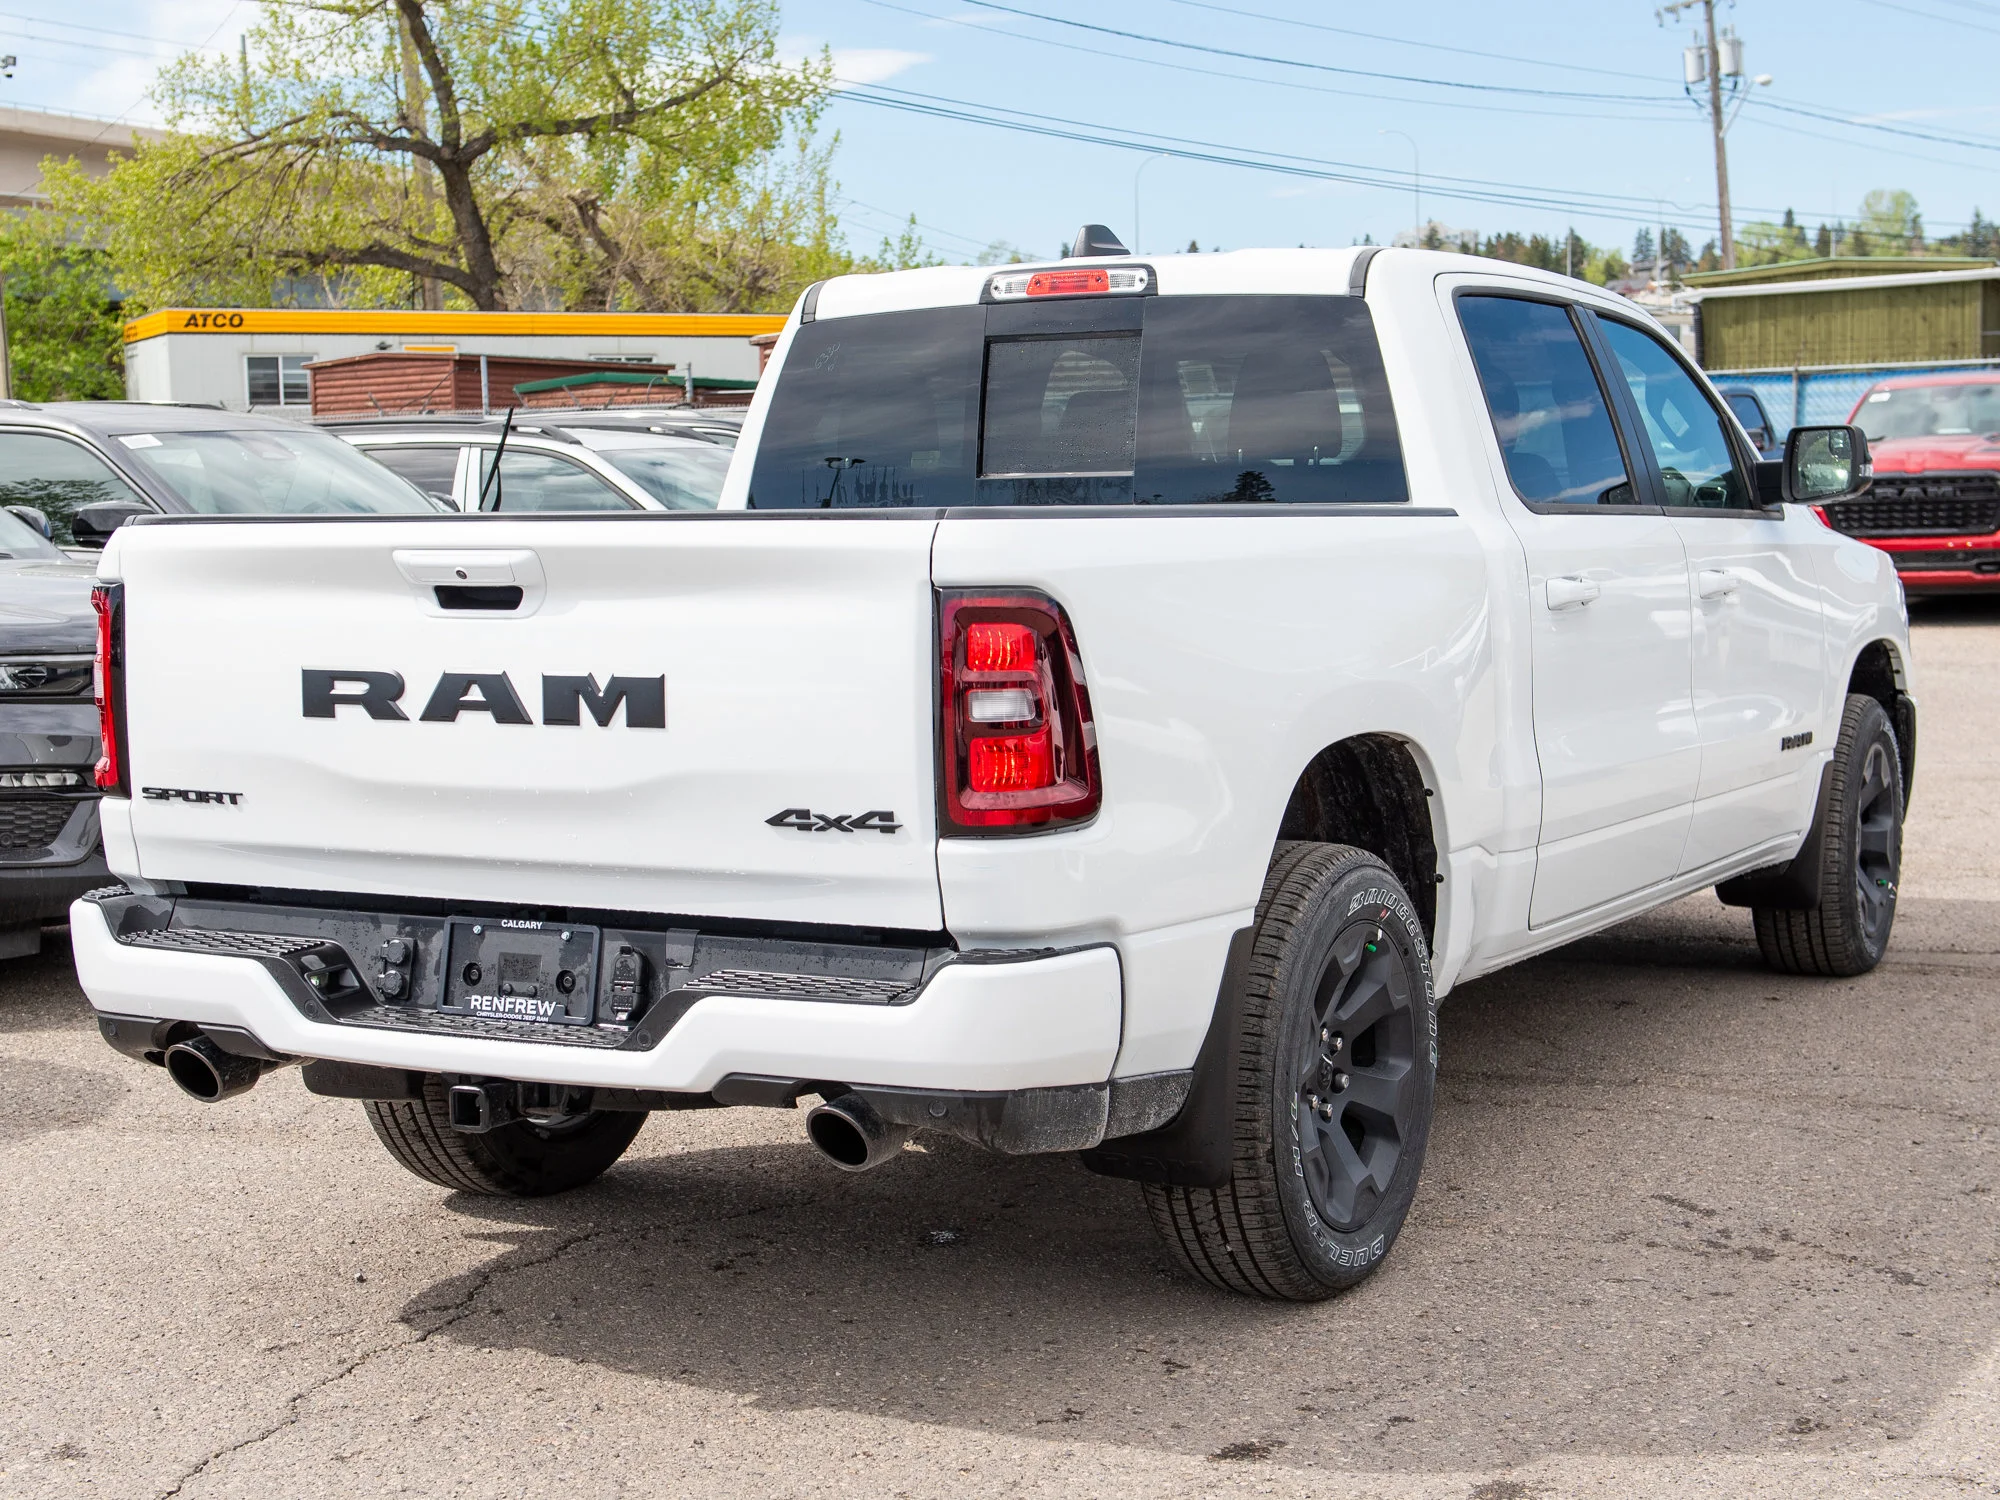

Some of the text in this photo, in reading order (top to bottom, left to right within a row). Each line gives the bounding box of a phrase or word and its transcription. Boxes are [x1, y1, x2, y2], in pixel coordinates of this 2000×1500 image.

[184, 313, 244, 328] ATCO
[302, 665, 665, 729] RAM
[1781, 731, 1813, 751] RAM
[142, 786, 243, 805] SPORT
[764, 808, 903, 834] 4x4
[501, 919, 543, 930] CALGARY
[1347, 888, 1438, 1069] BRIDGESTONE
[470, 994, 557, 1016] RENFREW
[1303, 1200, 1385, 1267] DUELER
